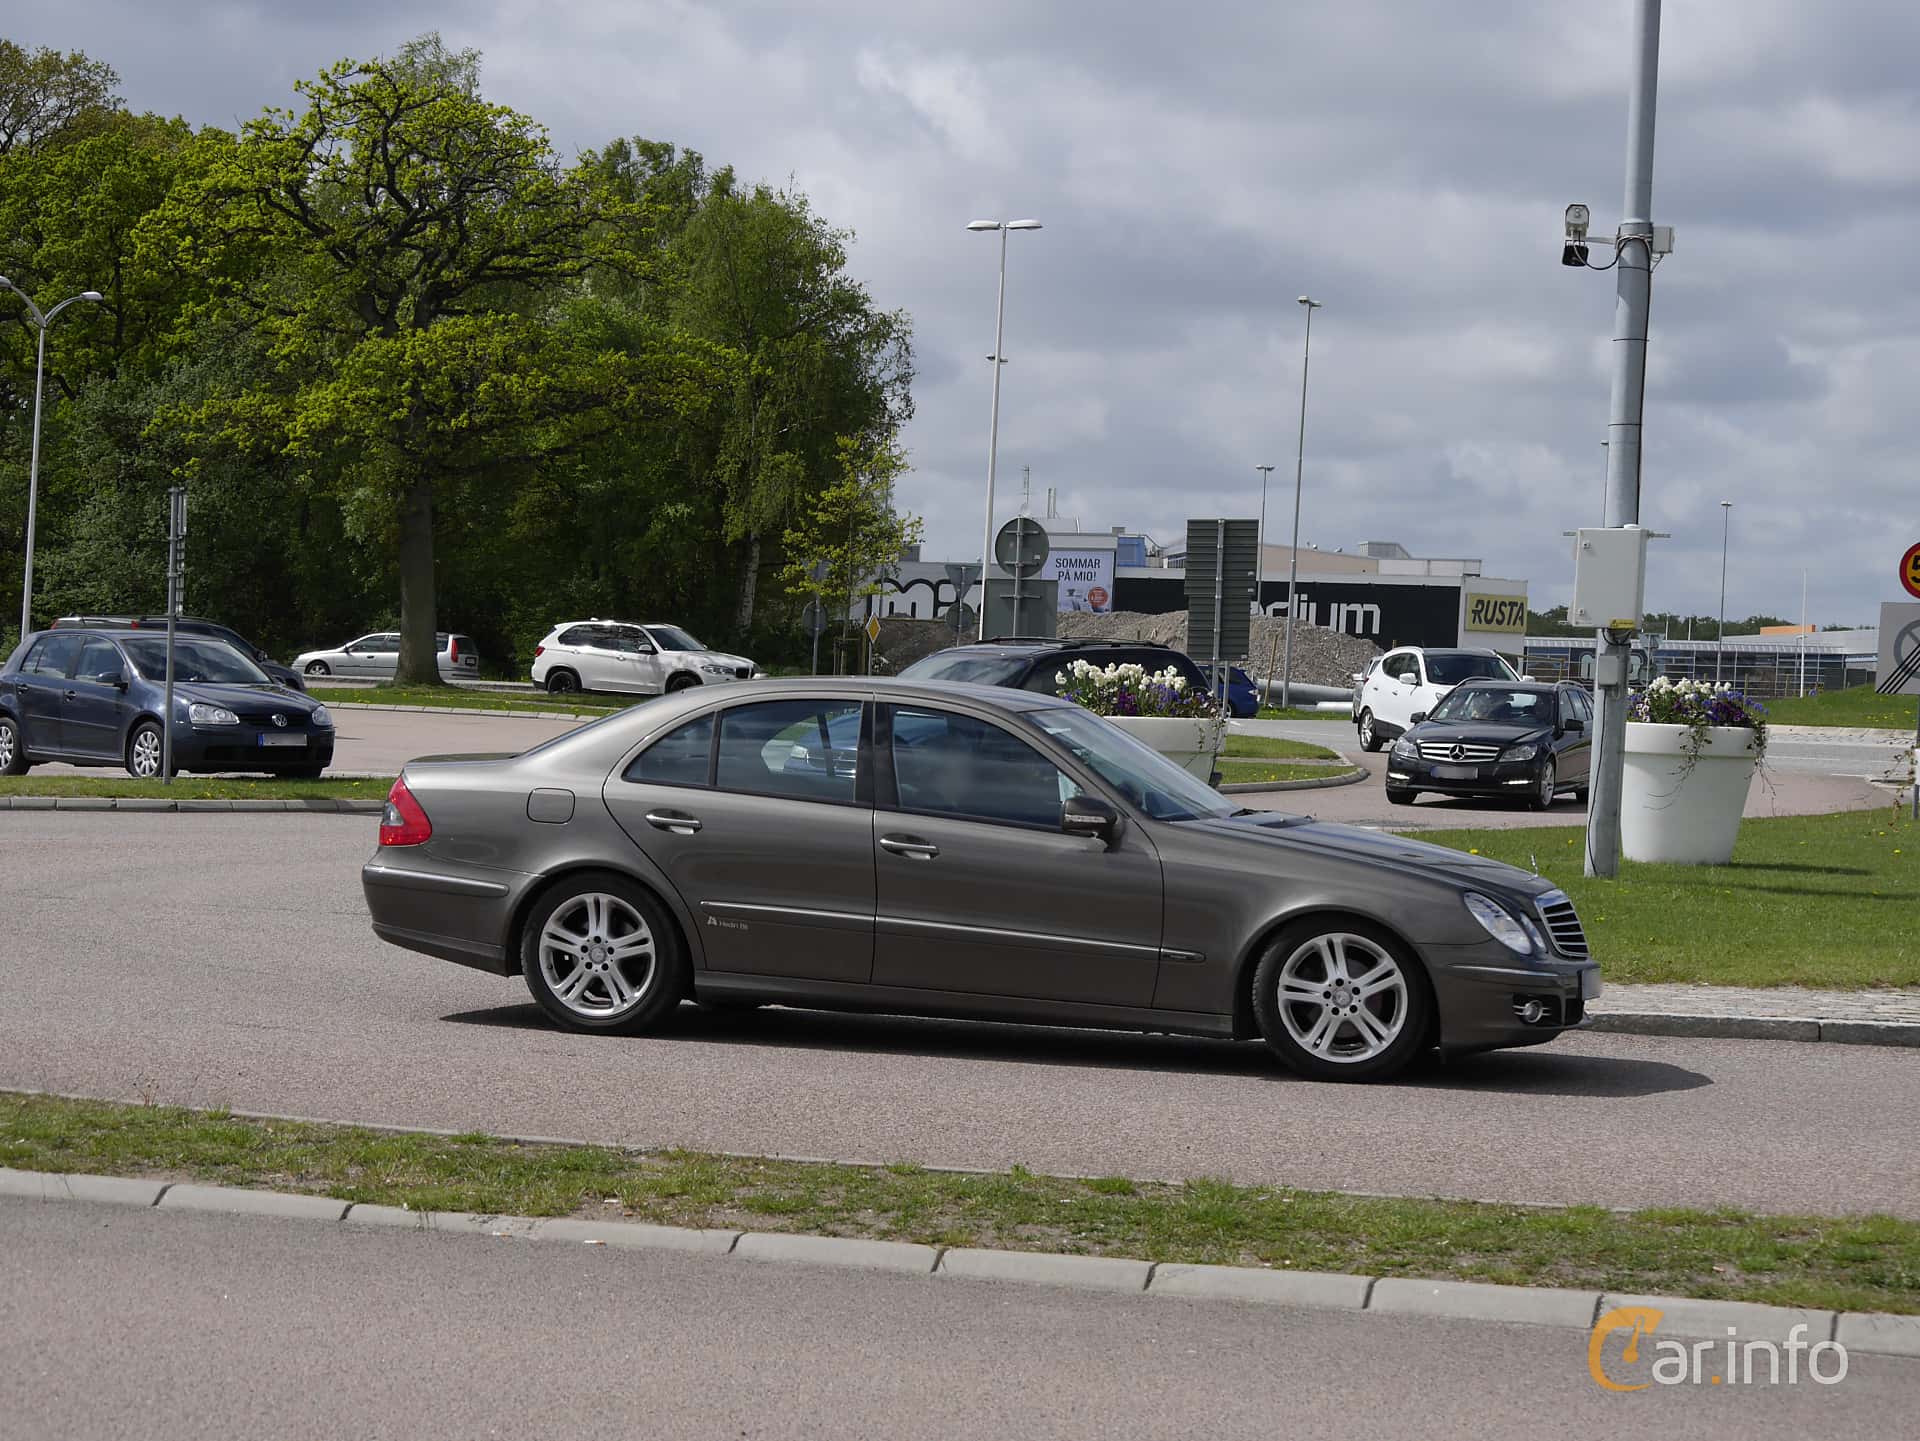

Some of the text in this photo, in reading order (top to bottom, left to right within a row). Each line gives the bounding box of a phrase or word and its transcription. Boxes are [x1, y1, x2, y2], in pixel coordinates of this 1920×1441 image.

[1055, 558, 1101, 569] SOMMAR
[1058, 569, 1097, 582] PÅ MIO!
[1471, 599, 1524, 626] RUSTA
